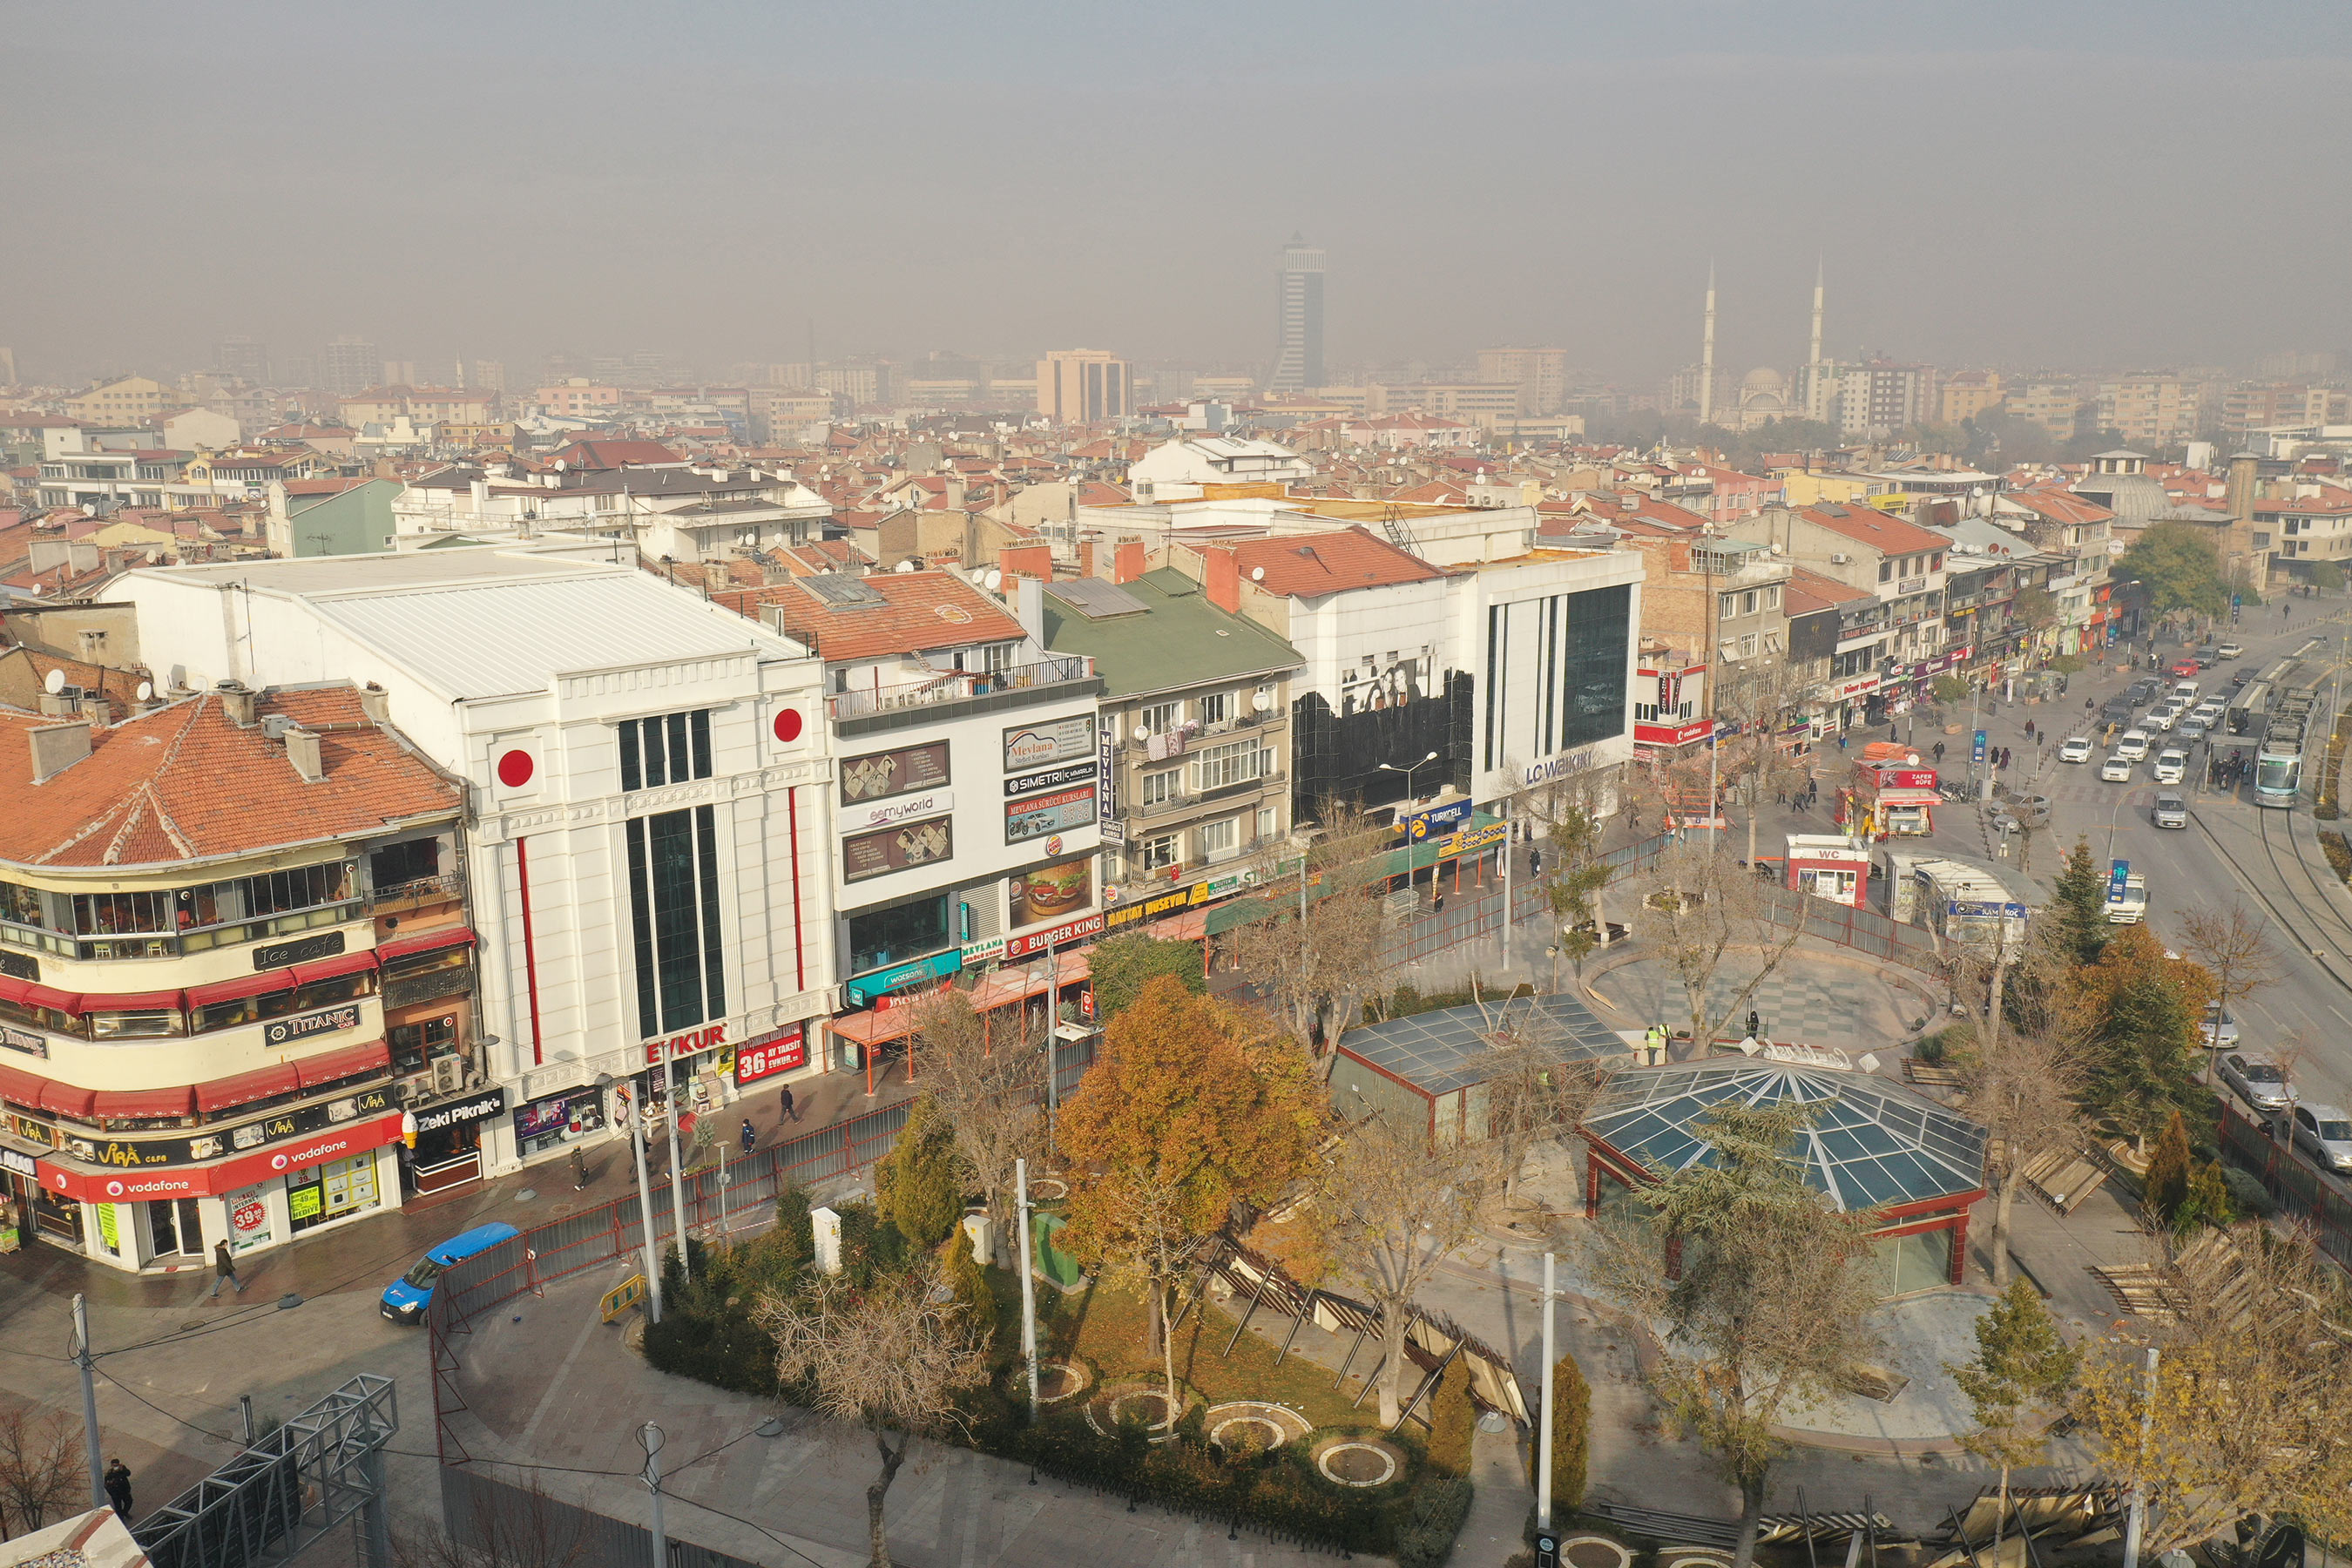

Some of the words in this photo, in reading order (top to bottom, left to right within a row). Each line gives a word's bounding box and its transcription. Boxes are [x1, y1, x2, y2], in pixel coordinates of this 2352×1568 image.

[1011, 743, 1053, 757] Mevlana
[1101, 734, 1111, 814] MEVLANA
[1526, 764, 1543, 785] LC
[1010, 802, 1037, 815] MEVLANA
[1430, 807, 1463, 823] TURKCELL
[1819, 850, 1840, 859] WC
[2004, 909, 2018, 917] KOÇ
[1029, 927, 1072, 950] BURGER
[1074, 917, 1101, 936] KING
[260, 949, 288, 965] Ice
[300, 934, 341, 957] cafe
[962, 939, 1004, 956] MEVLANA
[889, 970, 923, 983] watsons
[647, 1025, 726, 1064] EVKUR
[767, 1048, 777, 1058] AY
[740, 1051, 766, 1078] 36
[418, 1112, 450, 1132] Zeki
[291, 1141, 348, 1164] vodafone
[127, 1179, 189, 1193] vodafone
